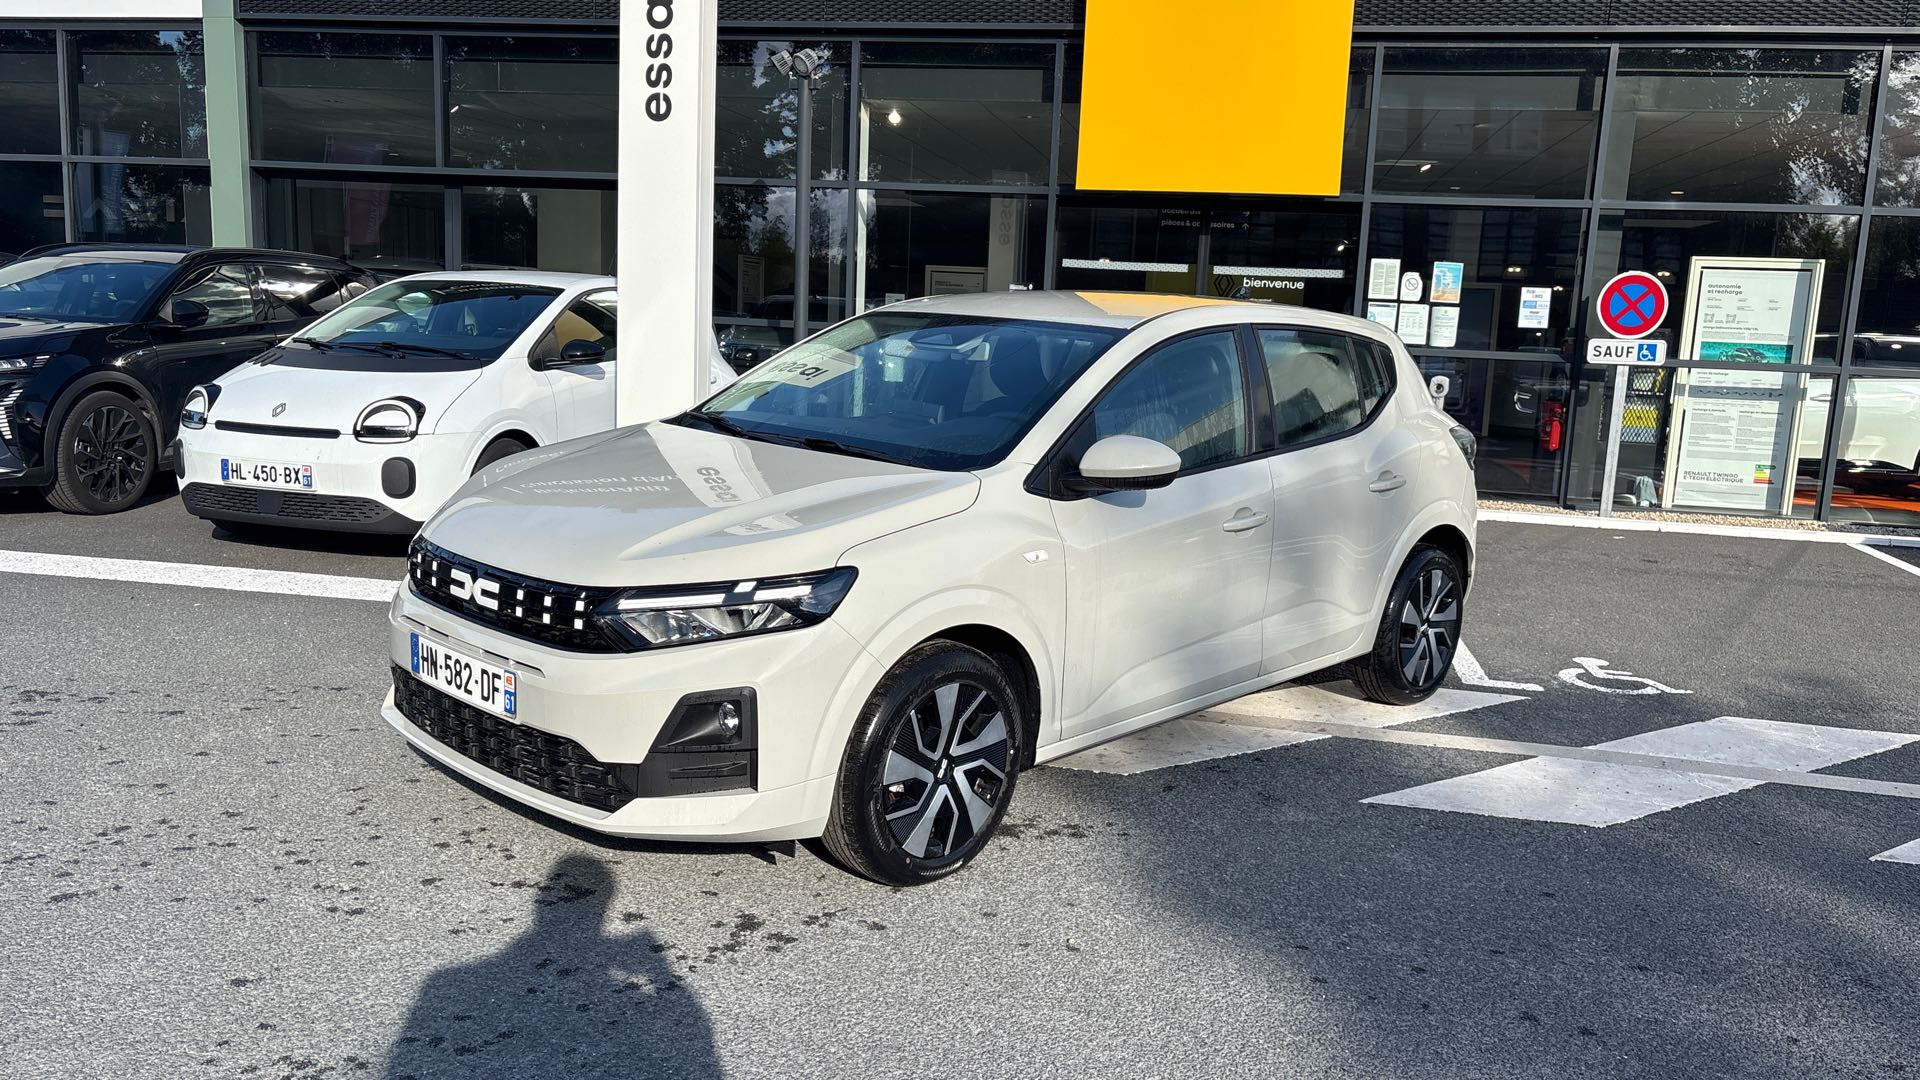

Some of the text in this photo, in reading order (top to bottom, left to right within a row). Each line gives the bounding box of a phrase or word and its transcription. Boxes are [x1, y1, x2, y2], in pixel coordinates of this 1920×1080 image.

[1243, 277, 1305, 289] bienvenue
[1592, 345, 1635, 358] SAUF
[230, 462, 302, 485] HL-450-BX
[303, 476, 311, 485] 61
[420, 642, 502, 705] HN-582-DF
[504, 693, 515, 713] 61
